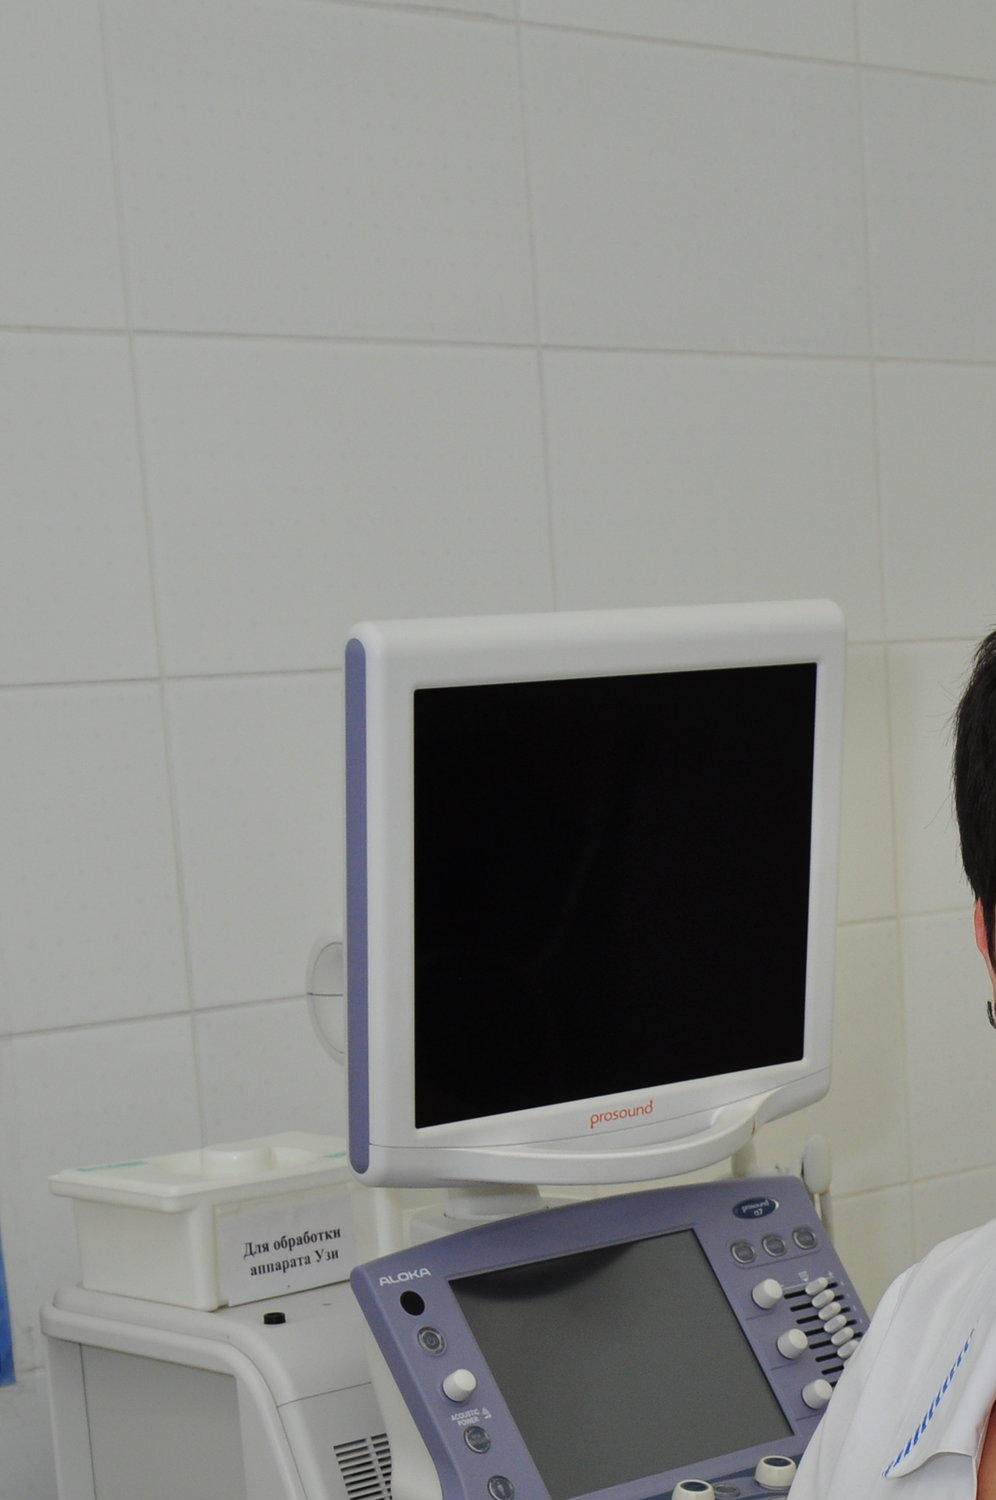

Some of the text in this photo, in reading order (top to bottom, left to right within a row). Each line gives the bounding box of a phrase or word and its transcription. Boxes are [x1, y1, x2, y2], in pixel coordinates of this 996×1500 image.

[589, 1099, 654, 1129] prosound
[243, 1228, 341, 1259] Для обработки
[250, 1249, 339, 1276] аппарата Узи
[379, 1267, 432, 1286] ALOKA
[451, 1409, 480, 1421] ACOUSTIC
[457, 1416, 480, 1426] POWER
